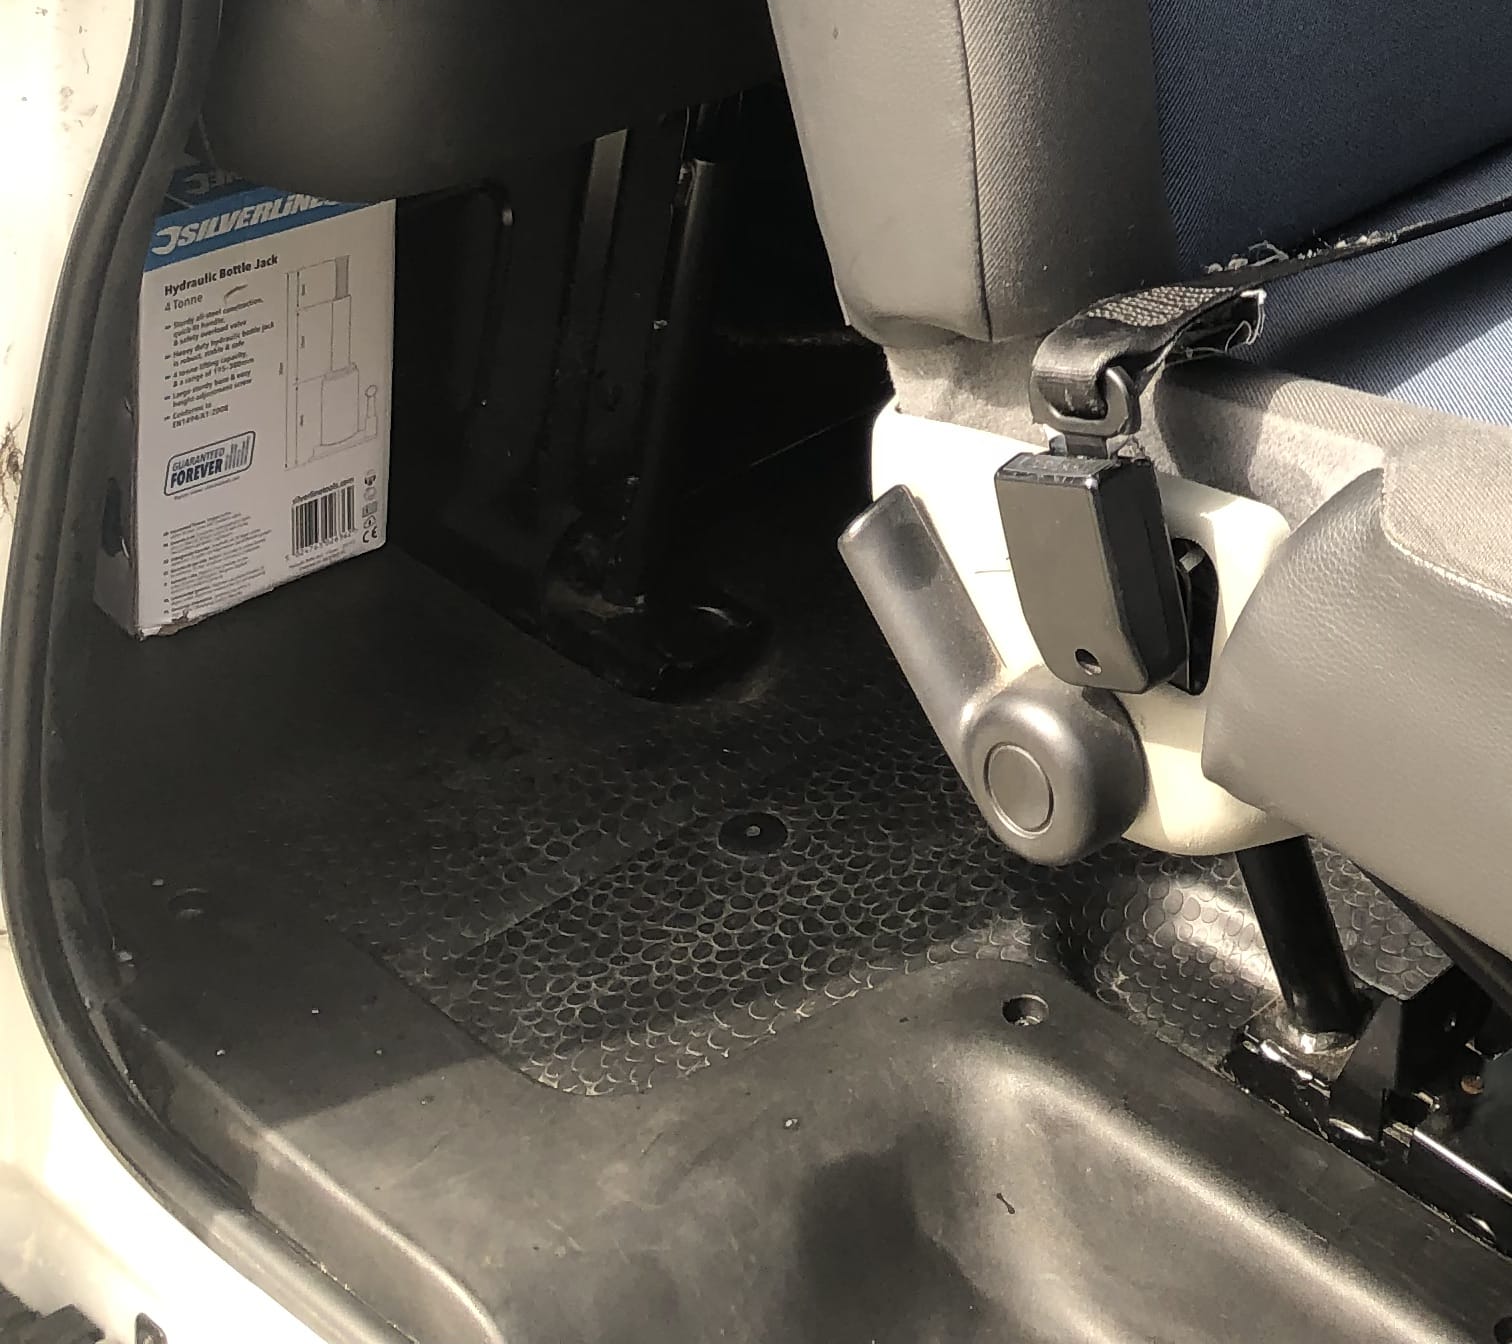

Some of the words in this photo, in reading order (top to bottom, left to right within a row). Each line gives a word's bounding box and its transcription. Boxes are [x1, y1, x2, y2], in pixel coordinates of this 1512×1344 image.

[164, 273, 217, 297] Hydraulic
[219, 261, 252, 279] Bottle
[254, 253, 278, 270] Jack
[164, 298, 171, 311] 4
[173, 293, 203, 310] Tonne
[262, 320, 274, 334] jack
[171, 446, 225, 472] GUARANTEED
[170, 458, 223, 489] FOREVER
